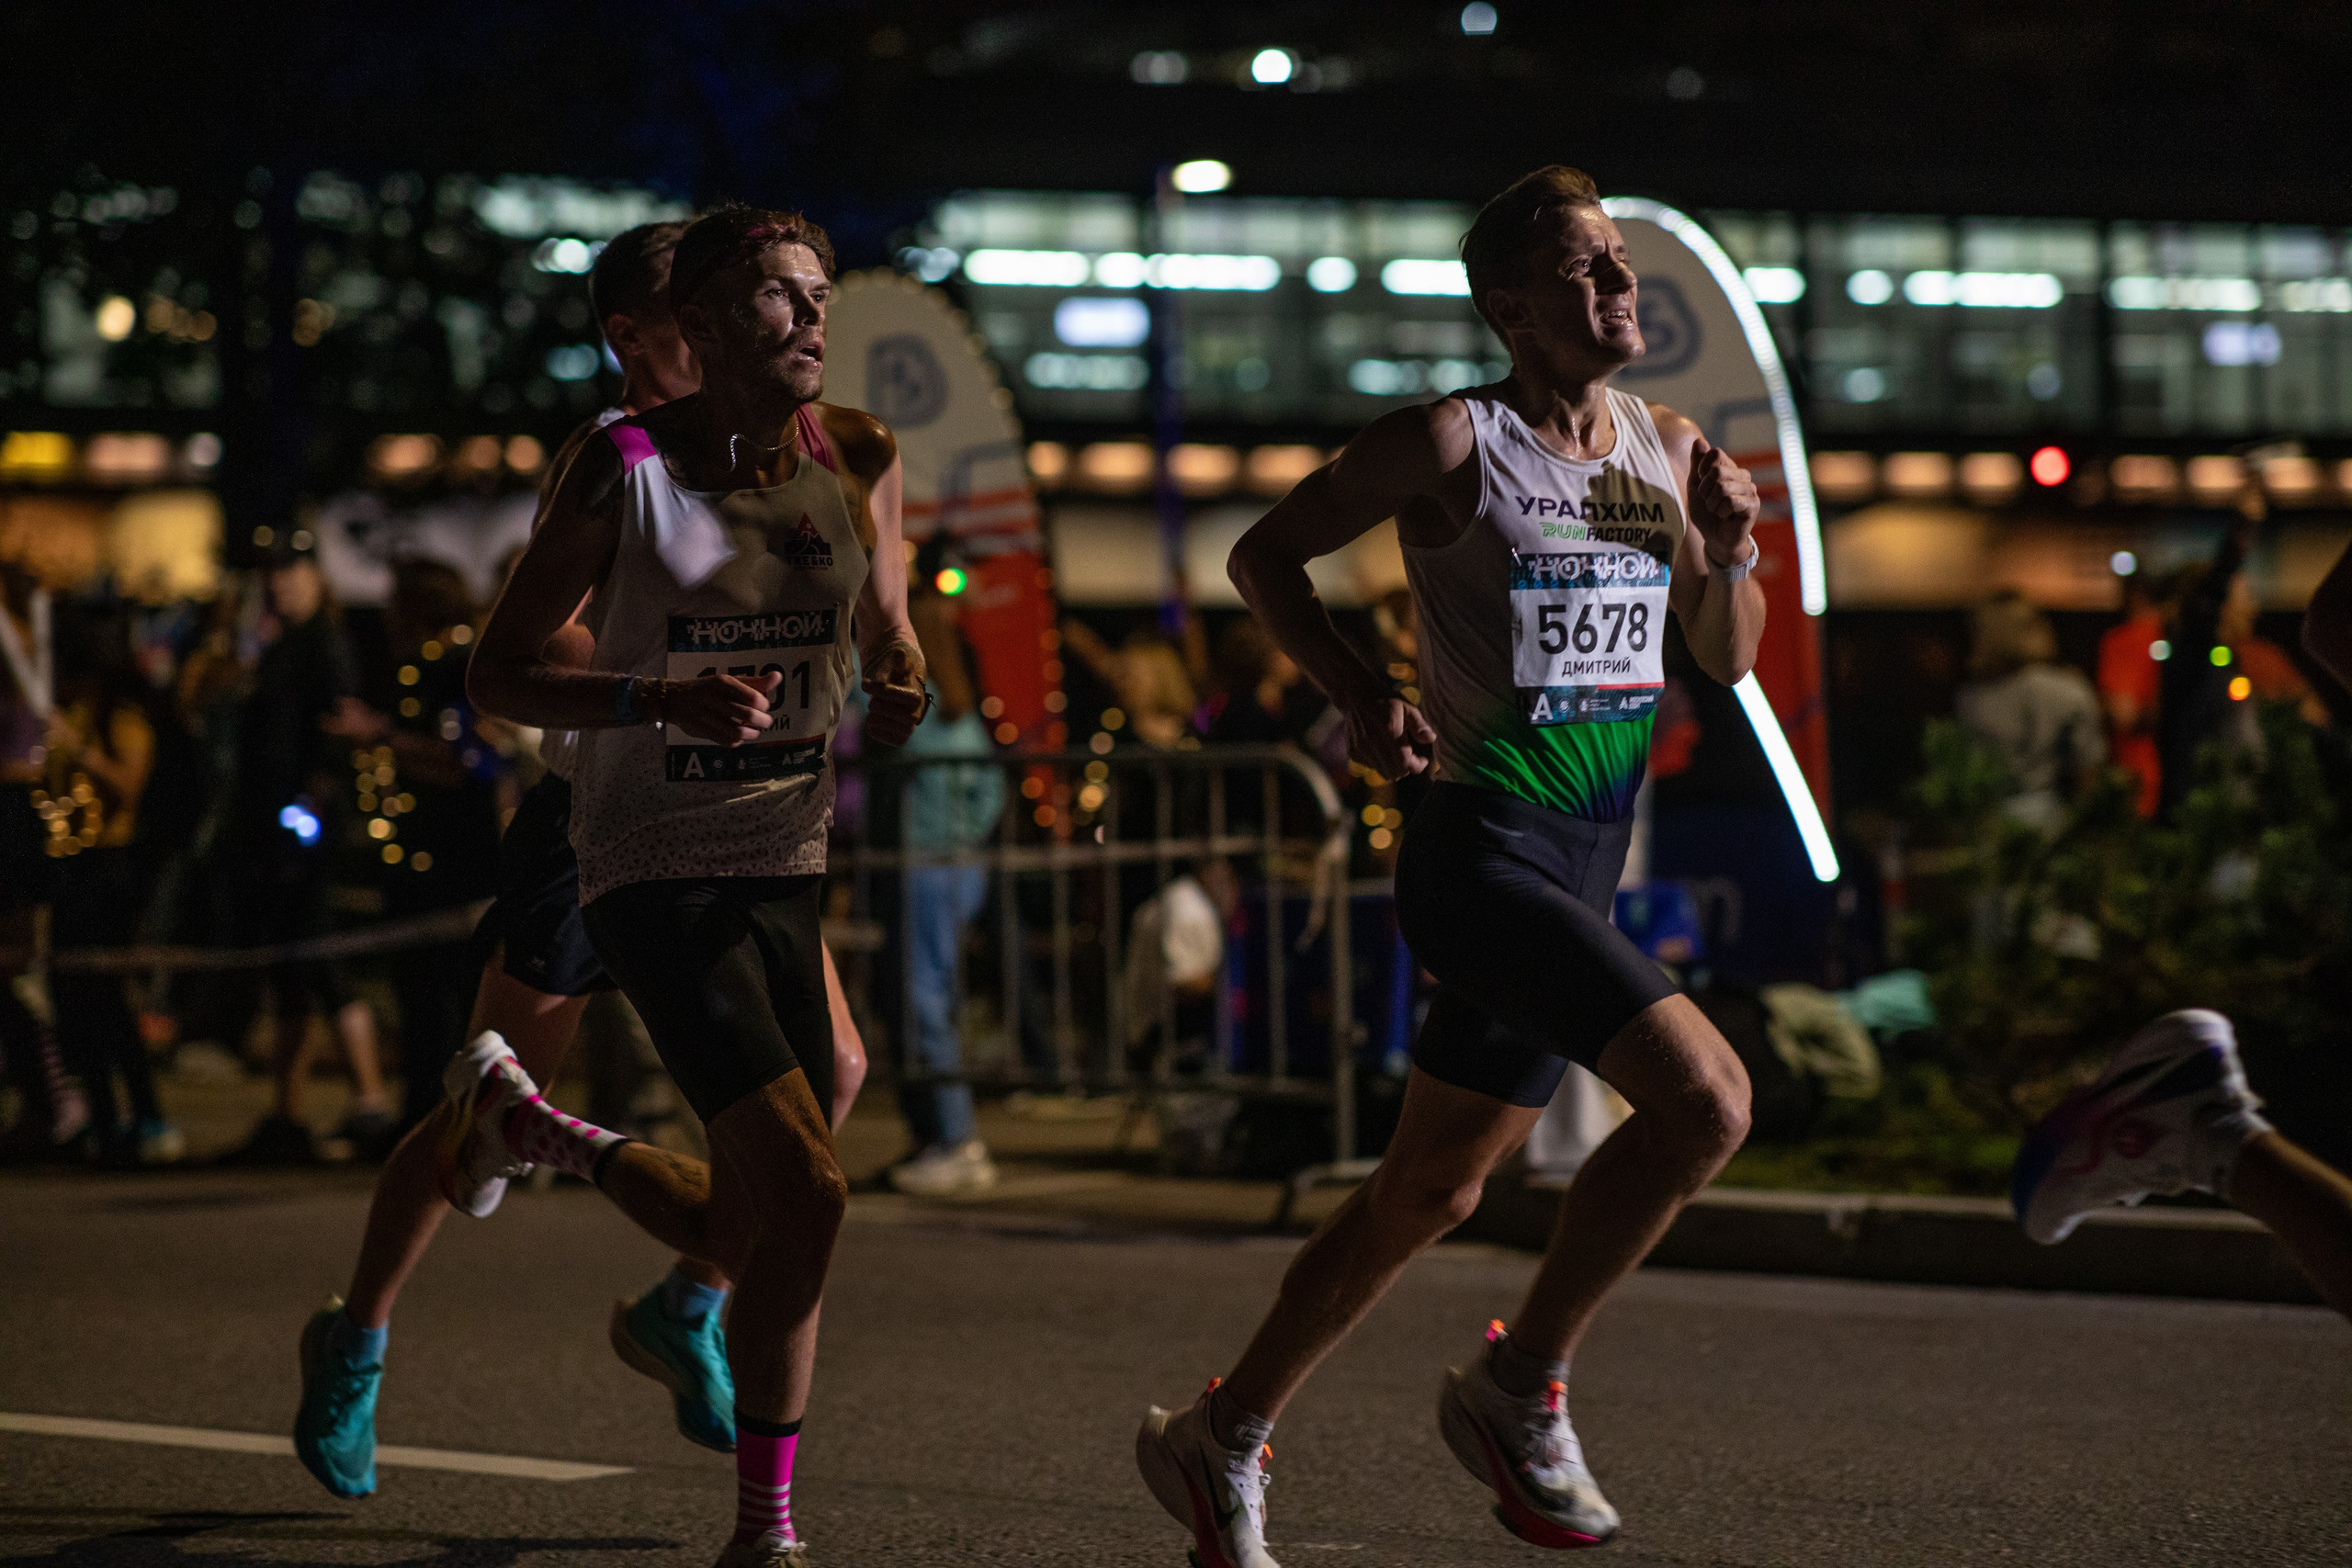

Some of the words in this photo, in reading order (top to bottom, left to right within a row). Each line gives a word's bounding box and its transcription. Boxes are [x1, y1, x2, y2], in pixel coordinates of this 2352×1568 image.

[1516, 496, 1665, 523] УРАЛХИМ
[1537, 603, 1649, 655] 5678
[1562, 656, 1631, 677] ДМИТРИЙ
[1532, 693, 1553, 721] A
[682, 751, 706, 779] A
